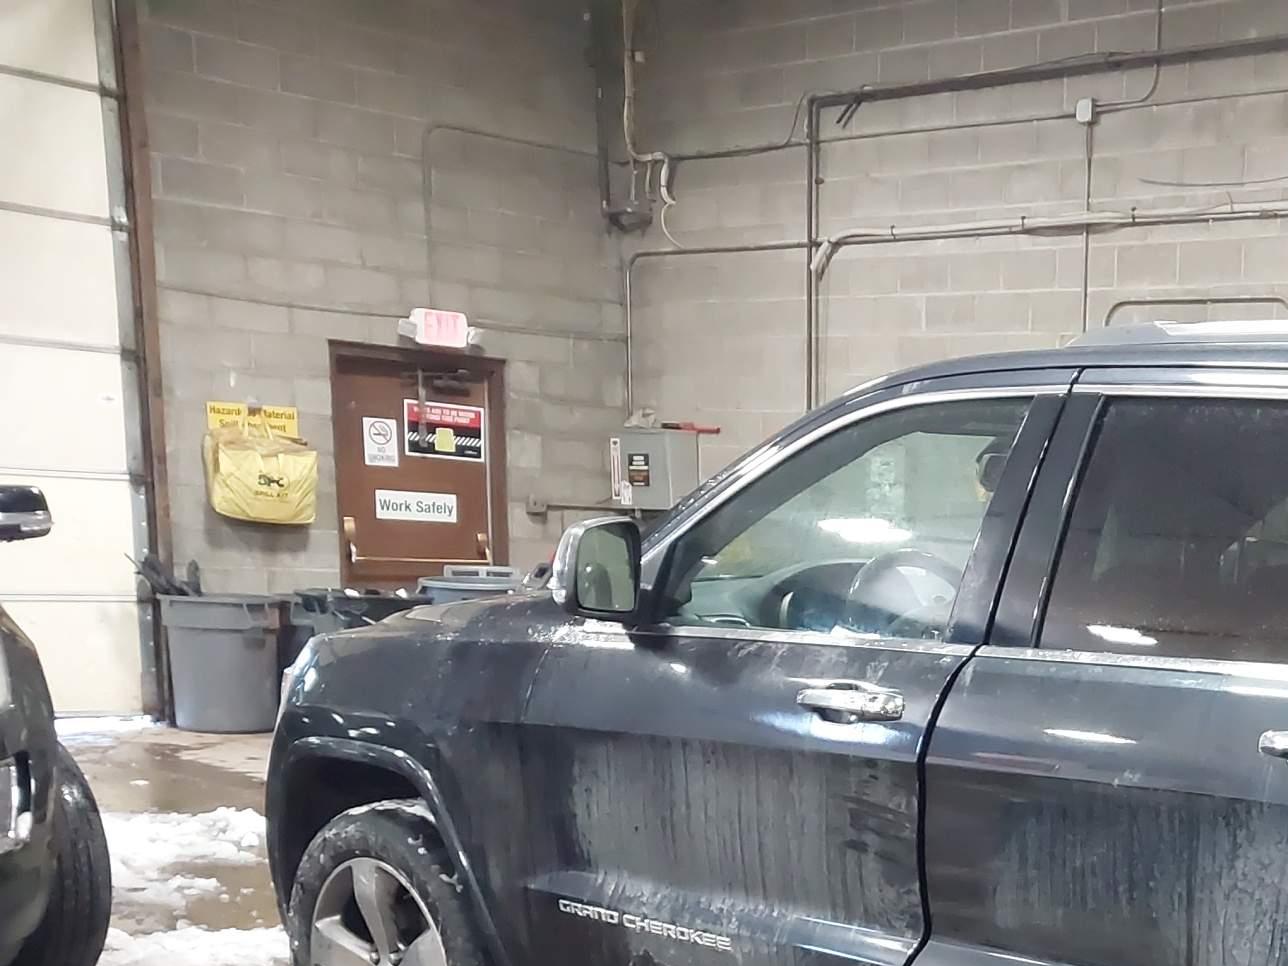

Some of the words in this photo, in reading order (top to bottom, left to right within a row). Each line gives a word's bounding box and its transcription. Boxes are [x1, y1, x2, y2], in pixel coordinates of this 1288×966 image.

[379, 498, 412, 512] Work
[416, 500, 454, 517] Safely
[558, 899, 619, 924] GRAND
[622, 913, 733, 951] CHEROKEE
